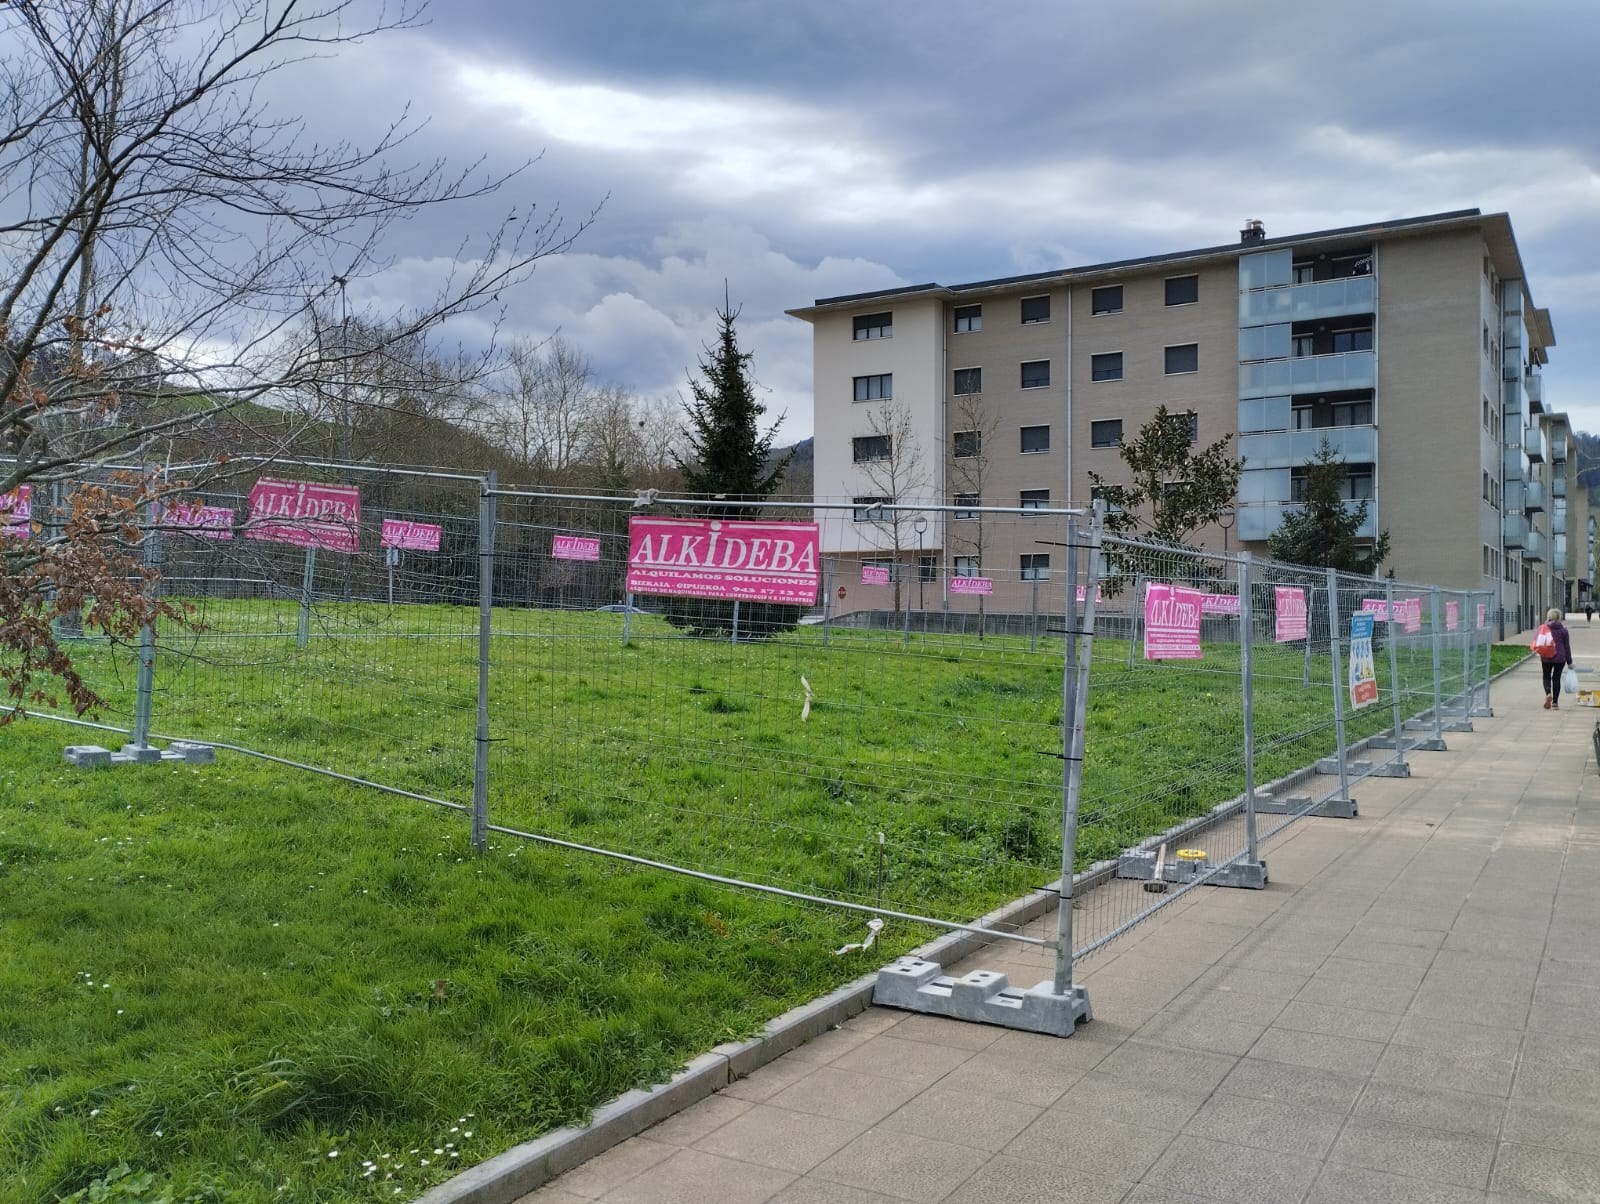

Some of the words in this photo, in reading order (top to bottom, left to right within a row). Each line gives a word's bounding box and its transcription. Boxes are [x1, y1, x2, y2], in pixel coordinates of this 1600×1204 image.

[631, 521, 817, 573] ALKIDEBA
[631, 569, 722, 581] ALQUILAMOS
[724, 575, 817, 586] SOLUCIONES
[630, 579, 670, 588] BIZKAIA
[676, 583, 726, 592] GIPUZKOA
